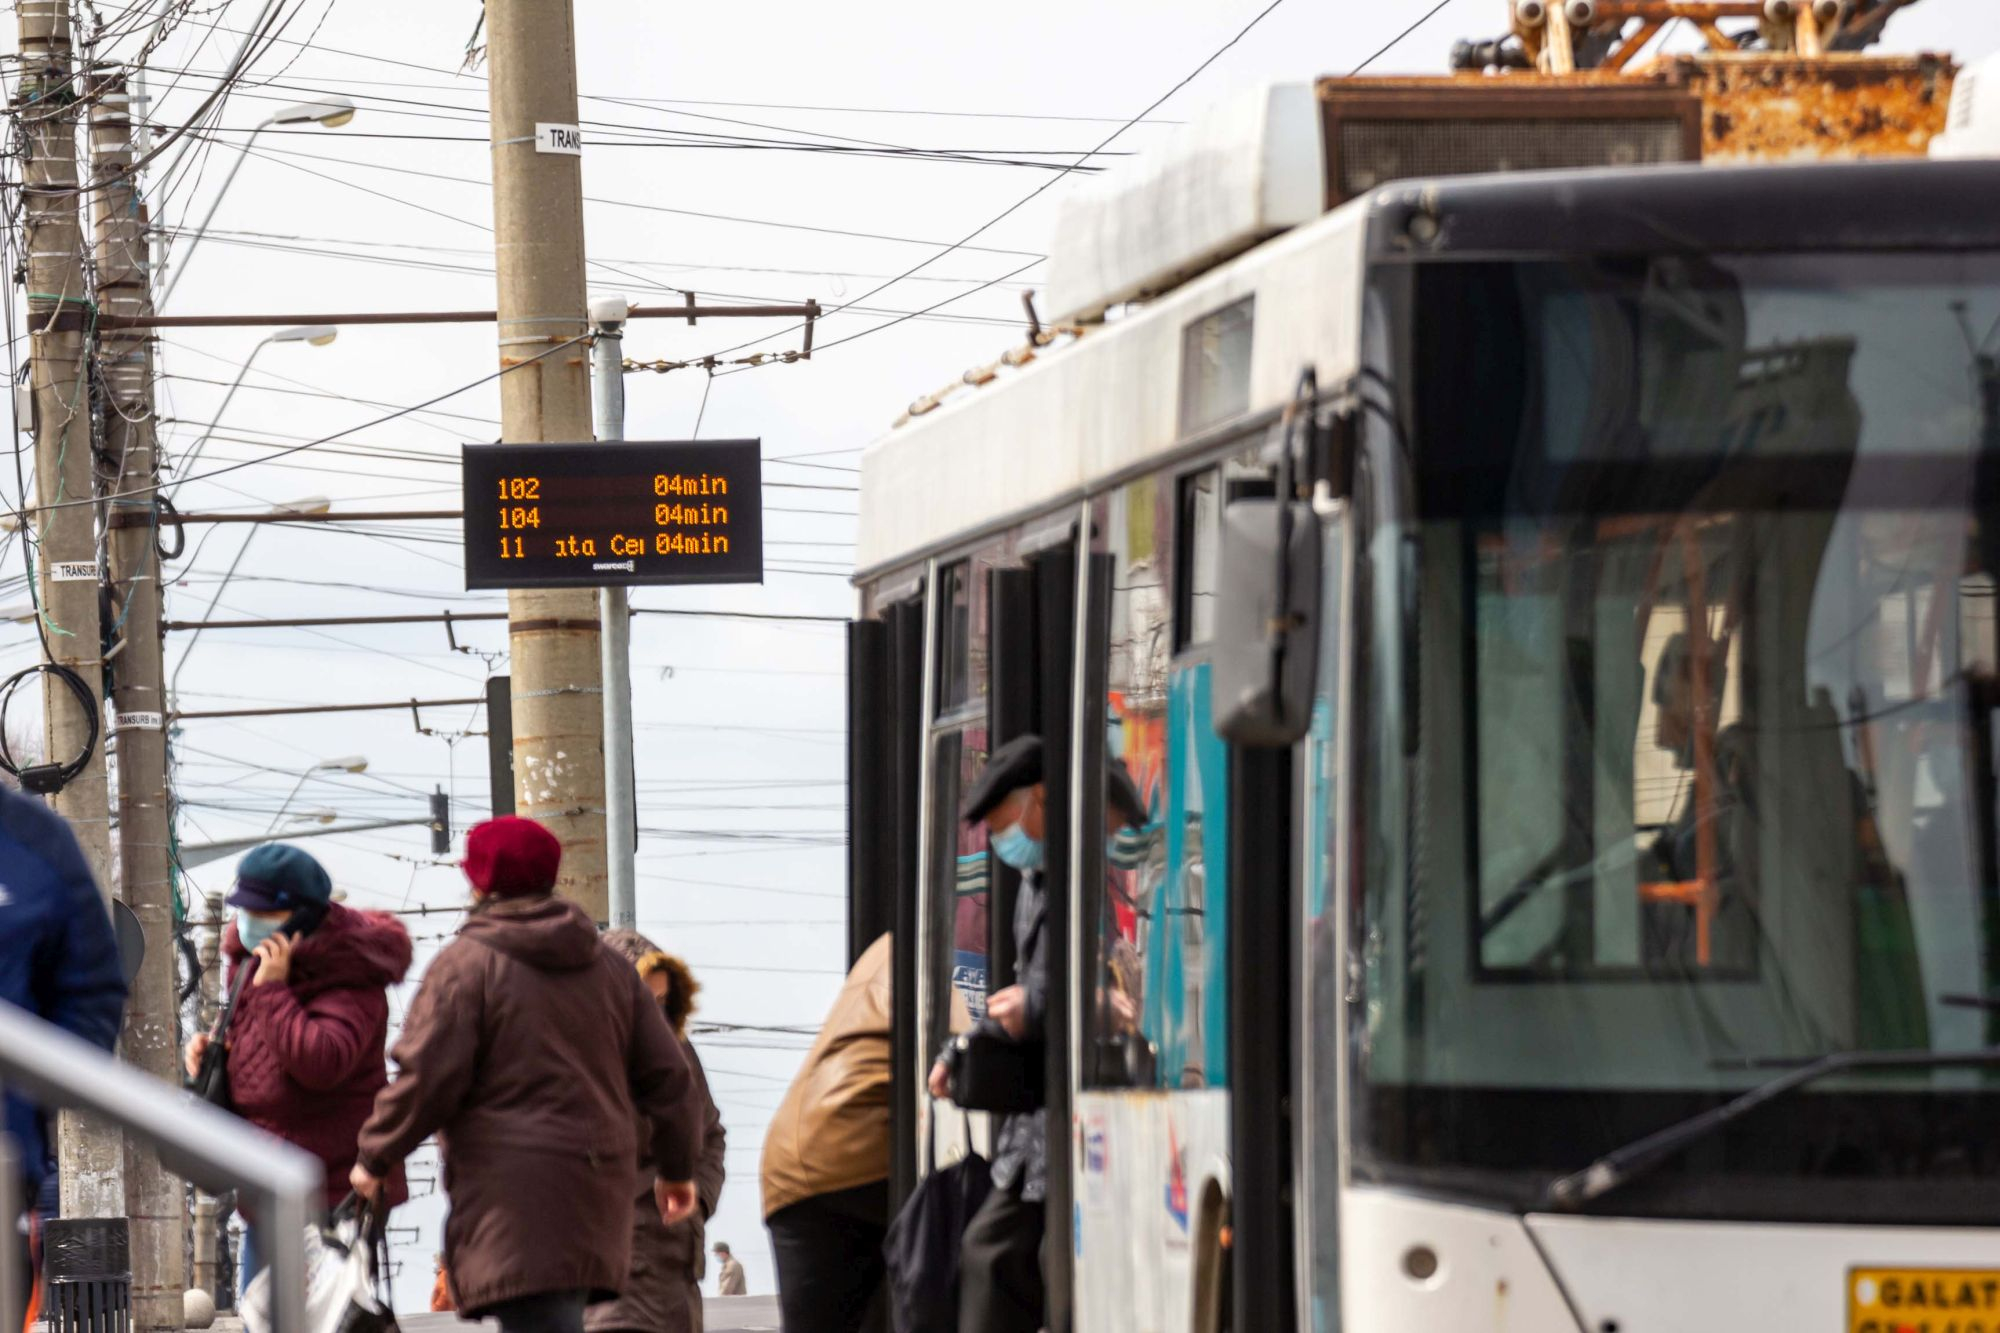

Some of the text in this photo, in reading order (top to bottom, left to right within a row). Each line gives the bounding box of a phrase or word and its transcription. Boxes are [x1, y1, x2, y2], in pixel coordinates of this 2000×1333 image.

[498, 473, 728, 500] 102 04min
[499, 503, 729, 529] 104 04min
[500, 536, 525, 559] 11
[610, 534, 645, 556] Ce
[656, 532, 730, 555] 04min
